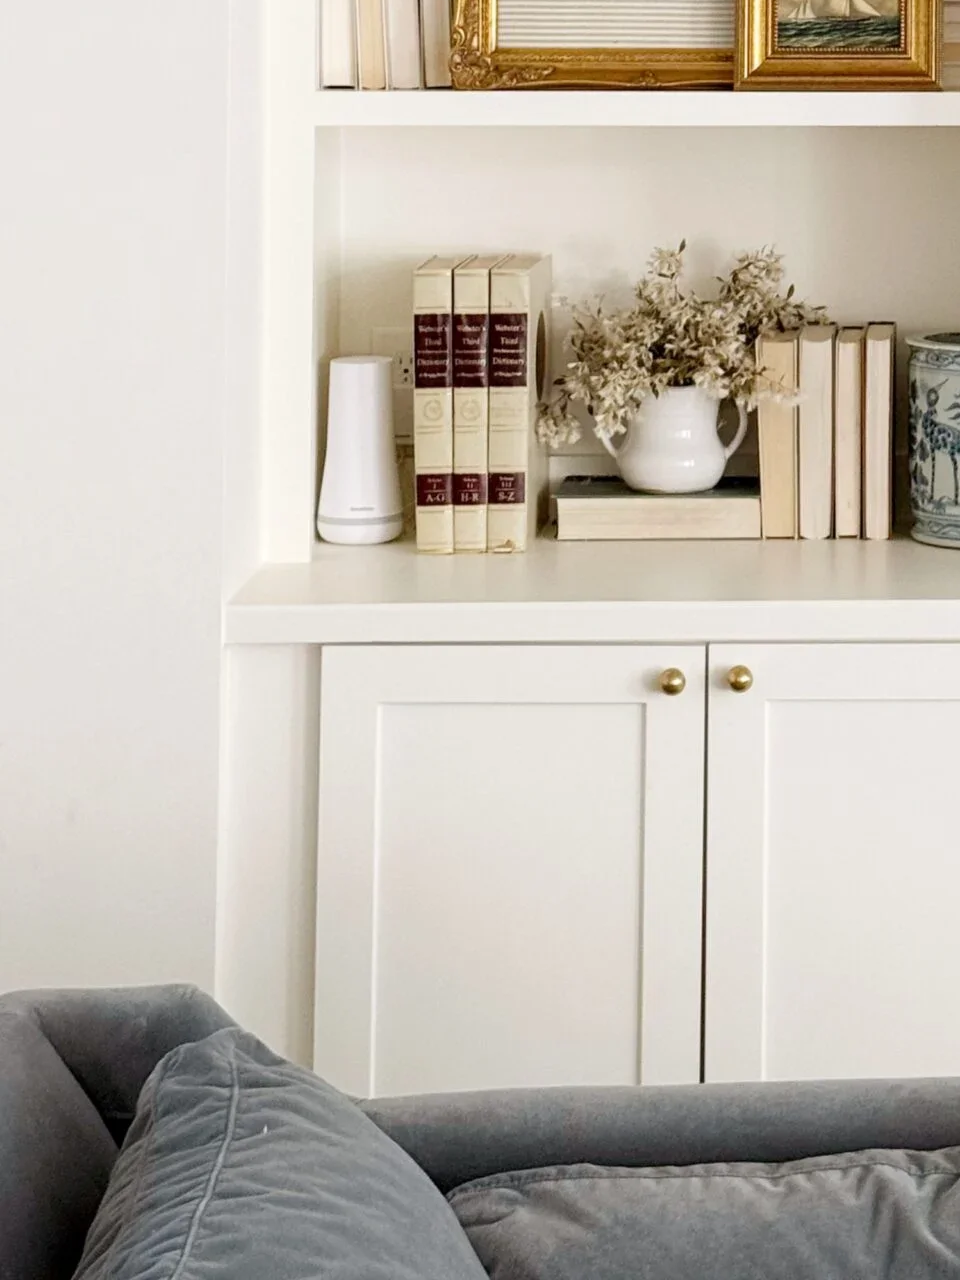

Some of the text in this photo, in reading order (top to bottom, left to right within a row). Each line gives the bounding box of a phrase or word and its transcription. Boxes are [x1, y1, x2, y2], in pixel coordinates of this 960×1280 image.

[492, 357, 525, 367] Dictionary
[460, 493, 479, 502] H-R
[497, 492, 515, 502] S-Z
